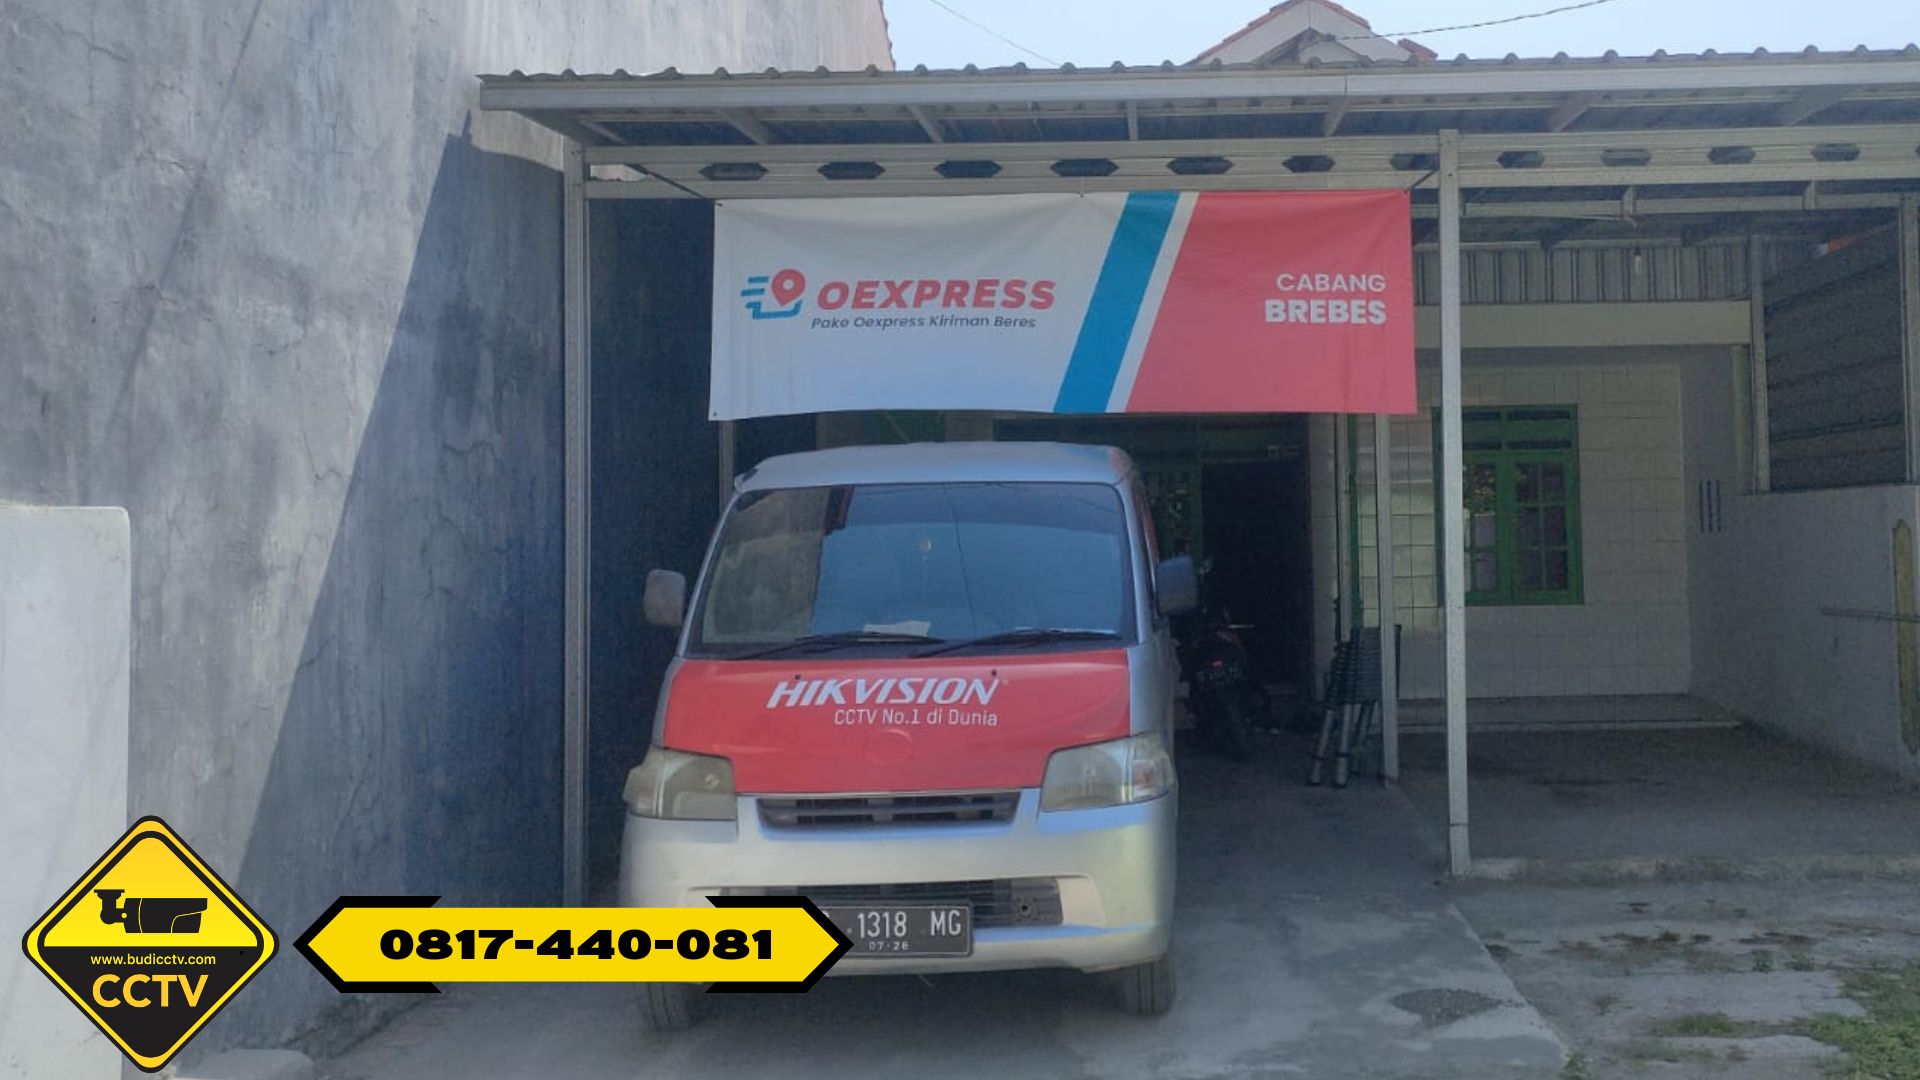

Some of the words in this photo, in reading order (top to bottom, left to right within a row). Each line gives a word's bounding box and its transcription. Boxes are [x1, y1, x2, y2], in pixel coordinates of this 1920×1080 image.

[817, 279, 1056, 310] OEXPRESS
[1276, 273, 1386, 292] CABANG
[811, 316, 849, 329] Pake
[853, 315, 925, 330] Oexpress
[929, 314, 989, 328] Kiriman
[993, 315, 1036, 328] Beres
[1264, 299, 1387, 325] BREBES
[767, 677, 999, 709] HIKVISION
[834, 709, 878, 725] CCTV
[882, 709, 920, 725] No.1
[926, 709, 942, 724] di
[949, 709, 998, 726] Dunia
[857, 911, 907, 939] 1318
[930, 909, 962, 936] MG
